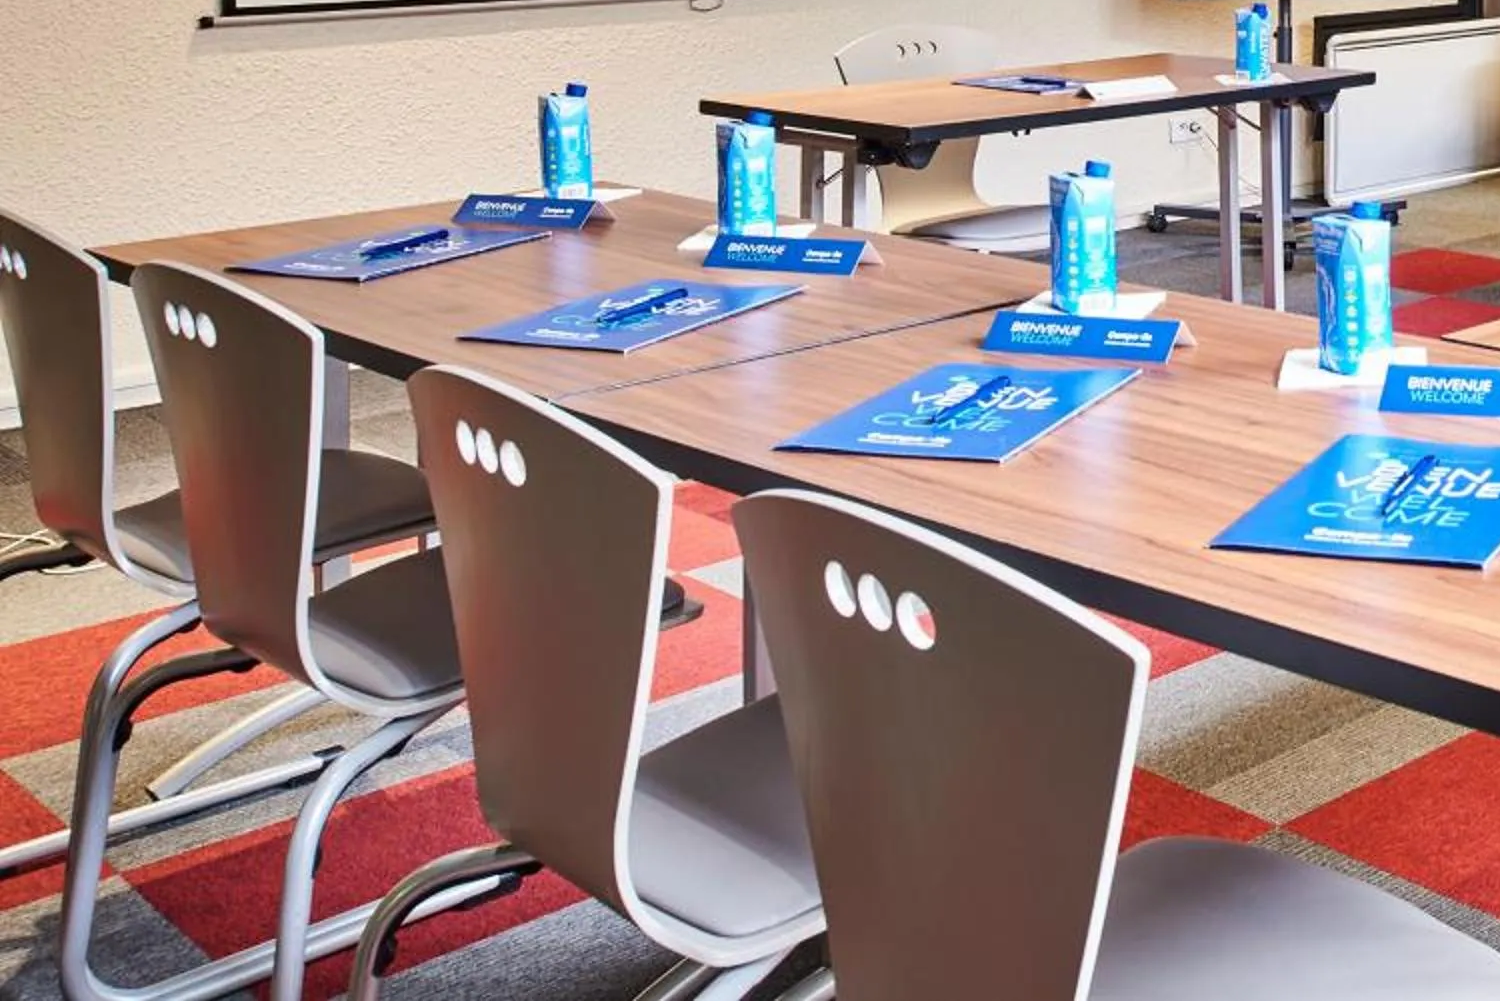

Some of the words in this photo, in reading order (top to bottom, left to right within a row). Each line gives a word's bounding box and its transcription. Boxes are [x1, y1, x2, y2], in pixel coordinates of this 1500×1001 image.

[727, 241, 787, 256] BIENVENUE
[1009, 320, 1083, 337] BIENVENUE
[1010, 332, 1074, 346] WELCOME
[1407, 375, 1493, 393] BIENVENUE
[1410, 390, 1487, 406] WELCOME
[1376, 457, 1493, 485] BEN
